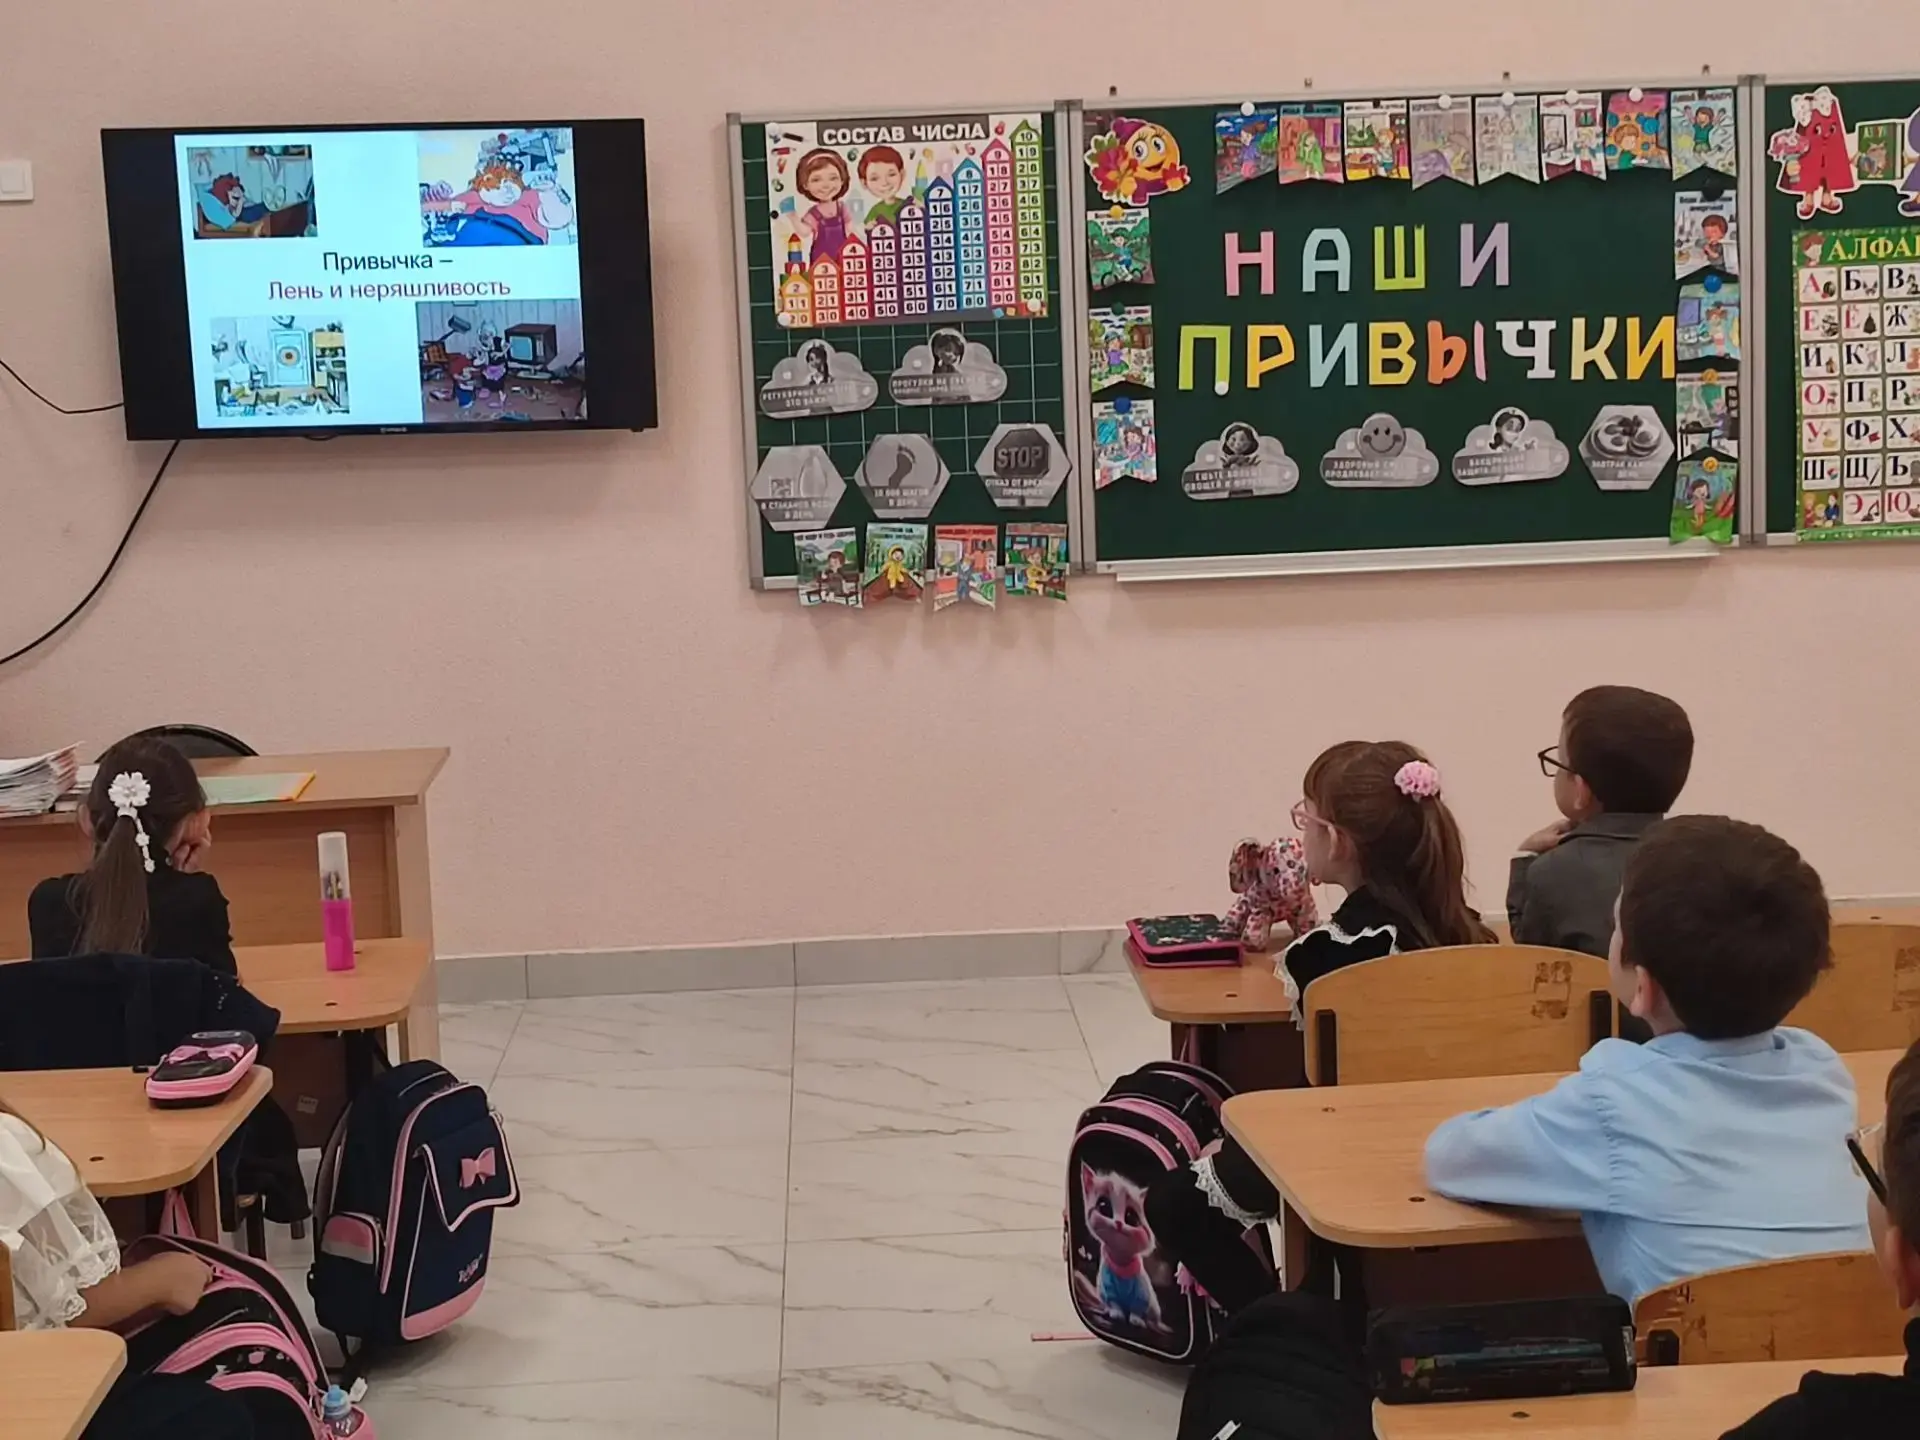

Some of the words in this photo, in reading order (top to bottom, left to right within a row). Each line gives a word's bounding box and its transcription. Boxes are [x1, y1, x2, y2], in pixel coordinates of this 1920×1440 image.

[823, 126, 905, 145] СОСТАВ
[912, 123, 986, 141] ЧИСЛА
[1020, 132, 1032, 140] 10
[1019, 148, 1023, 156] 1
[988, 166, 996, 176] 1
[1019, 164, 1024, 172] 2
[990, 182, 995, 191] 2
[1002, 182, 1007, 190] 7
[1020, 180, 1025, 188] 3
[1031, 179, 1036, 188] 7
[937, 188, 943, 197] 7
[961, 185, 965, 194] 1
[972, 185, 978, 193] 7
[991, 198, 996, 206] 3
[1020, 194, 1027, 204] 4
[932, 204, 937, 212] 1
[961, 201, 967, 209] 2
[908, 208, 914, 216] 6
[1020, 212, 1026, 220] 5
[1032, 211, 1038, 220] 5
[962, 217, 968, 225] 3
[974, 217, 980, 225] 5
[990, 213, 998, 223] 4
[1003, 214, 1009, 222] 5
[902, 222, 910, 232] 1
[915, 223, 921, 232] 5
[932, 220, 938, 228] 2
[944, 219, 951, 229] 5
[879, 226, 885, 236] 5
[992, 230, 998, 238] 5
[1003, 228, 1010, 238] 4
[1032, 226, 1040, 236] 4
[933, 236, 939, 244] 3
[944, 235, 952, 245] 4
[962, 232, 969, 242] 4
[974, 232, 981, 242] 4
[875, 242, 879, 250] 1
[885, 241, 893, 251] 4
[903, 238, 910, 248] 2
[915, 238, 922, 248] 4
[1022, 244, 1027, 252] 7
[1034, 243, 1039, 252] 3
[849, 245, 856, 255] 4
[963, 249, 969, 257] 5
[975, 249, 981, 257] 3
[1004, 245, 1010, 254] 3
[905, 255, 911, 263] 3
[916, 255, 922, 263] 3
[934, 252, 940, 260] 4
[946, 251, 951, 260] 3
[1224, 222, 1509, 296] НАШИ
[323, 252, 433, 274] Привычка
[875, 258, 882, 268] 2
[886, 257, 894, 267] 3
[993, 262, 999, 270] 7
[1005, 261, 1011, 270] 2
[1034, 259, 1040, 267] 2
[934, 268, 940, 276] 5
[946, 267, 953, 277] 2
[976, 265, 981, 273] 2
[876, 274, 882, 282] 3
[887, 273, 894, 283] 2
[904, 270, 912, 280] 4
[916, 270, 924, 280] 2
[1035, 275, 1040, 283] 1
[965, 281, 970, 290] 7
[976, 280, 983, 290] 1
[1006, 277, 1010, 285] 1
[1802, 273, 1820, 293] А
[1845, 270, 1861, 291] Б
[1887, 268, 1904, 289] В
[268, 281, 323, 300] Лень
[330, 285, 343, 299] и
[350, 280, 511, 302] неряшливость
[906, 287, 912, 295] 5
[917, 286, 924, 296] 1
[946, 283, 954, 293] 1
[876, 290, 884, 300] 4
[888, 289, 895, 299] 1
[1006, 293, 1012, 301] 0
[1022, 291, 1033, 299] 10
[1036, 290, 1042, 300] 0
[936, 300, 942, 308] 7
[947, 299, 954, 307] 0
[976, 296, 983, 305] 0
[877, 306, 883, 314] 5
[889, 305, 896, 315] 0
[918, 302, 925, 312] 0
[1804, 310, 1820, 331] Е
[1846, 304, 1860, 329] Ё
[1886, 305, 1908, 327] Ж
[1178, 316, 1676, 391] ПРИВЫЧКИ
[1846, 344, 1864, 365] К
[1887, 341, 1907, 362] Л
[1804, 384, 1826, 405] О
[1847, 381, 1864, 402] П
[1892, 379, 1906, 400] Р
[1806, 422, 1824, 442] У
[1846, 420, 1870, 440] Ф
[1888, 417, 1908, 439] Х
[996, 446, 1043, 468] STOP
[1804, 460, 1825, 481] Ш
[1846, 457, 1869, 480] Щ
[1887, 456, 1909, 476] Ъ
[1846, 493, 1863, 515] Э
[1888, 491, 1911, 512] Ю
